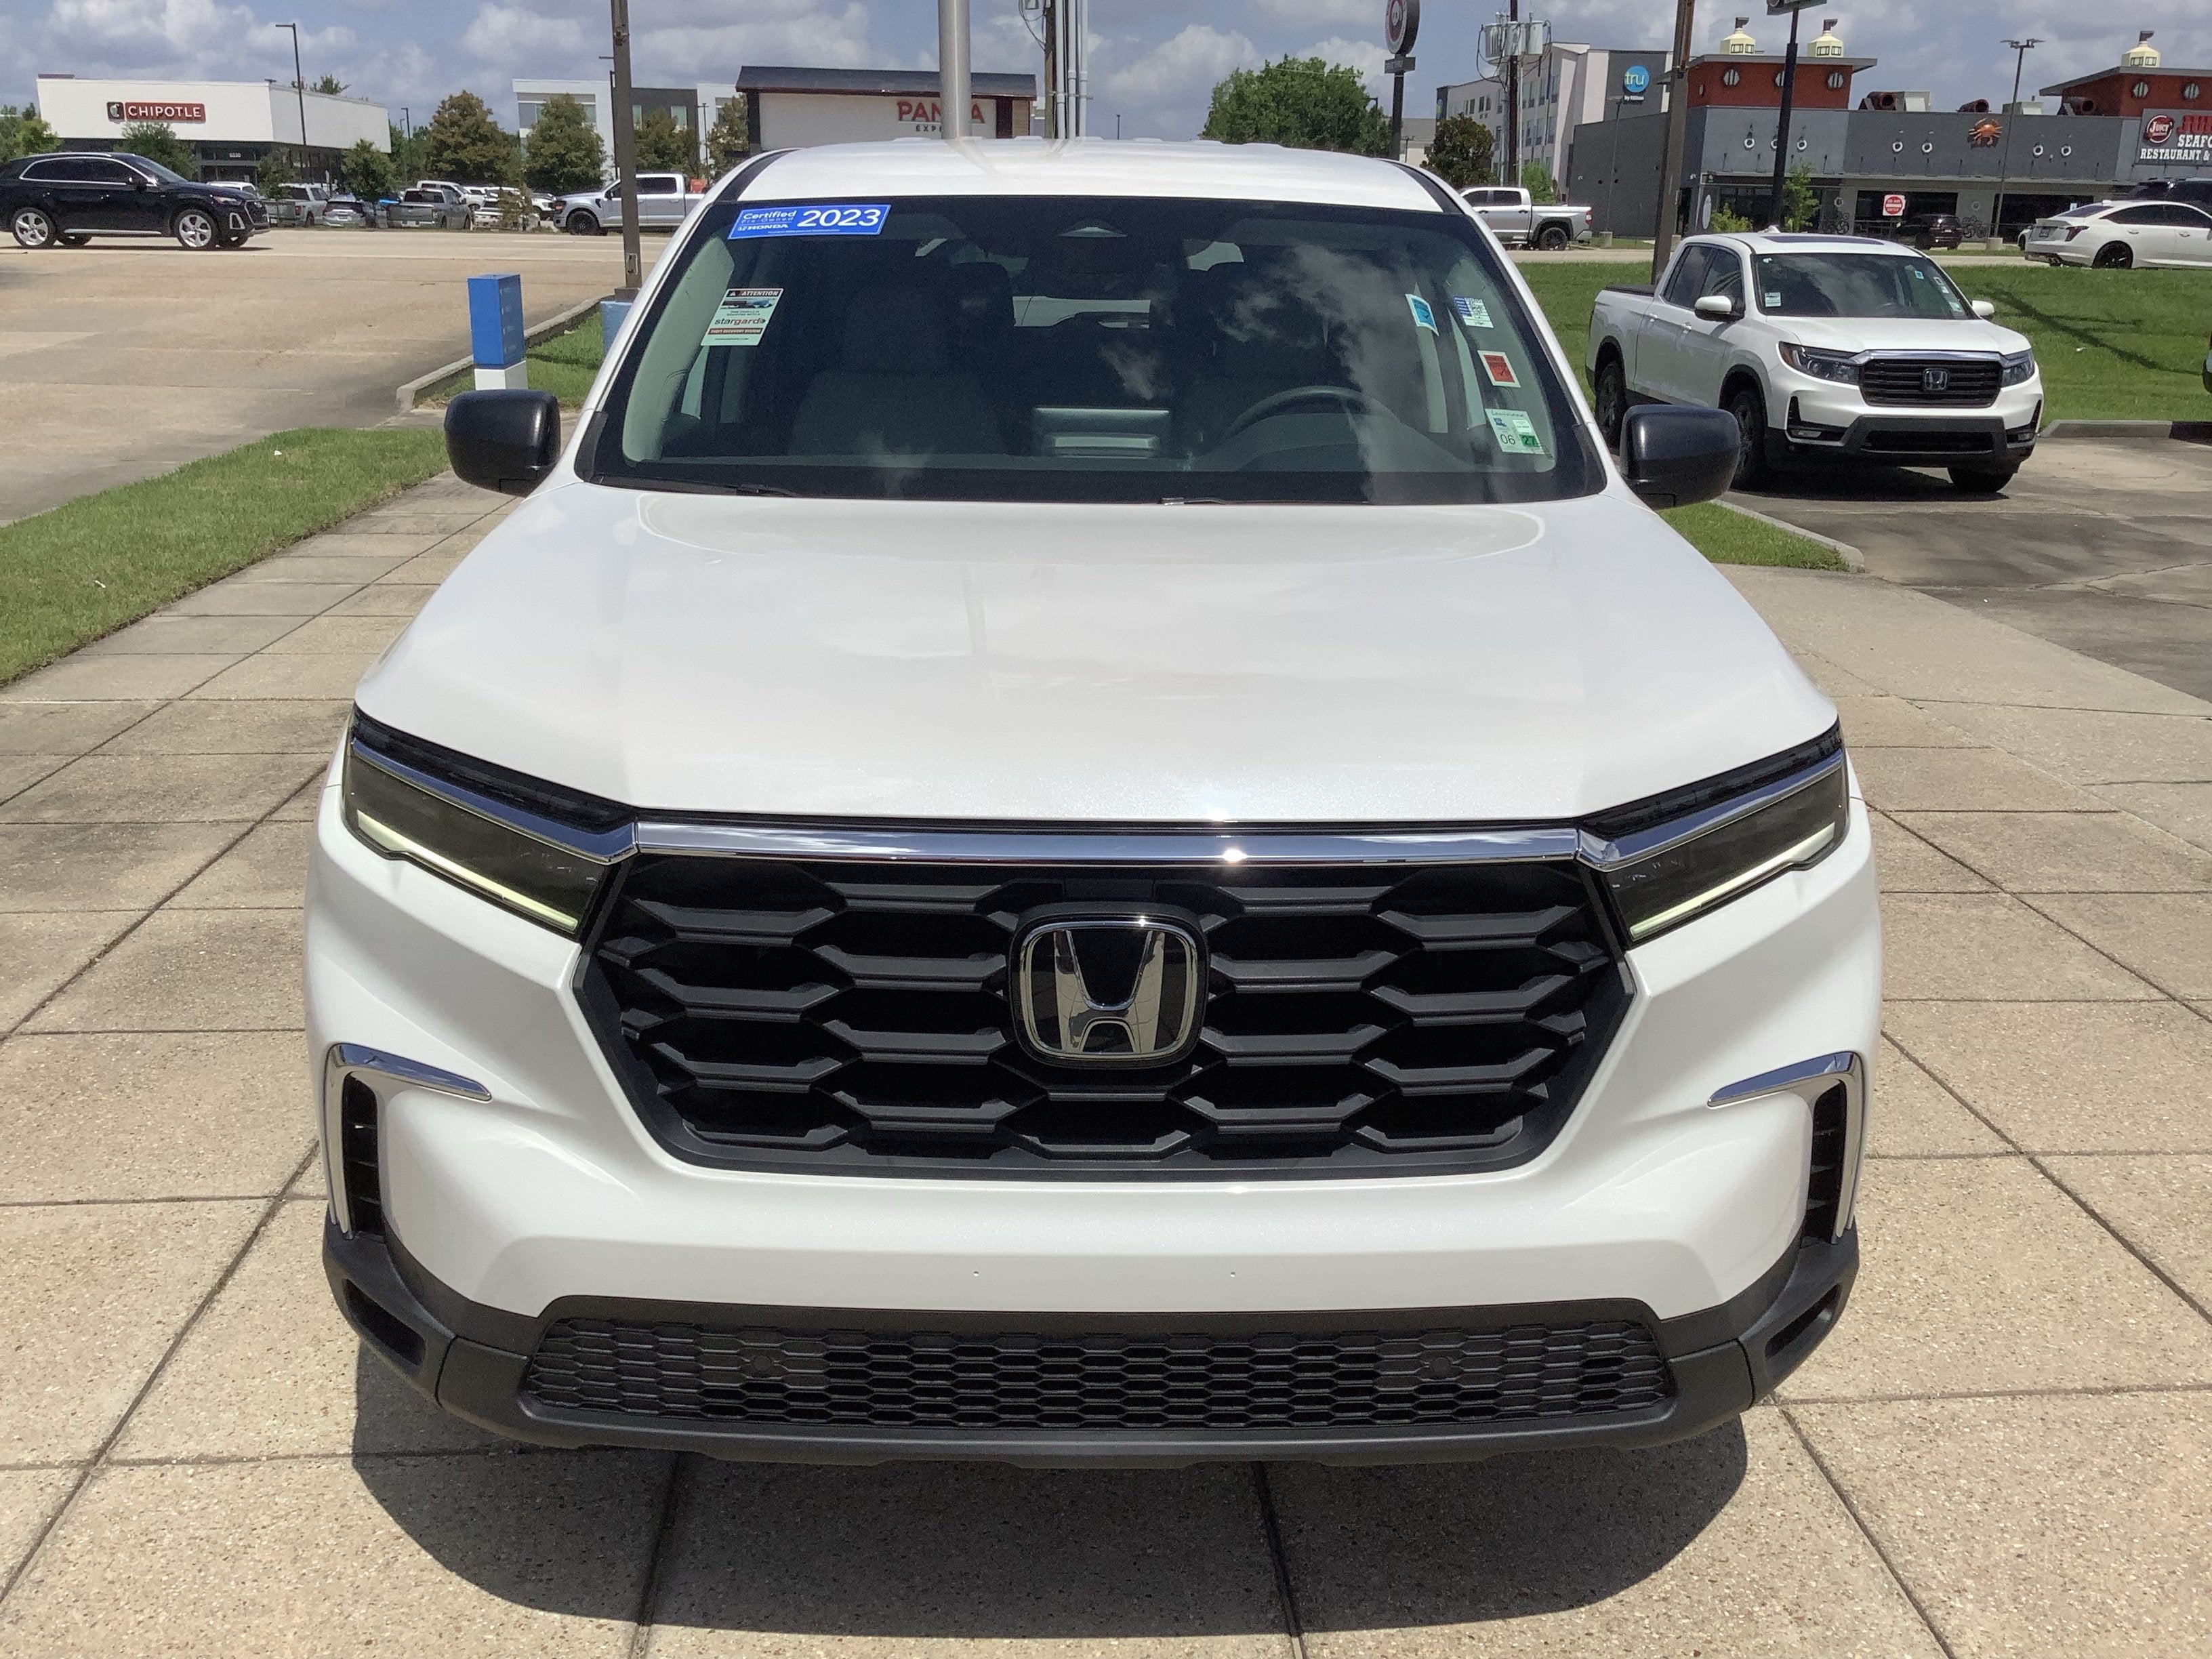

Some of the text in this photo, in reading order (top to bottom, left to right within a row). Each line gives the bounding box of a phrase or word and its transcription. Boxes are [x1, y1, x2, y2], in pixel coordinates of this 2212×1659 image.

[1625, 72, 1645, 85] tru
[127, 106, 201, 117] CHIPOTLE
[897, 100, 985, 123] PANA
[2140, 148, 2210, 161] RESTAURANT &
[743, 210, 797, 220] Certified
[797, 209, 881, 227] 2023
[1500, 434, 1516, 445] 06
[1522, 435, 1536, 446] 27
